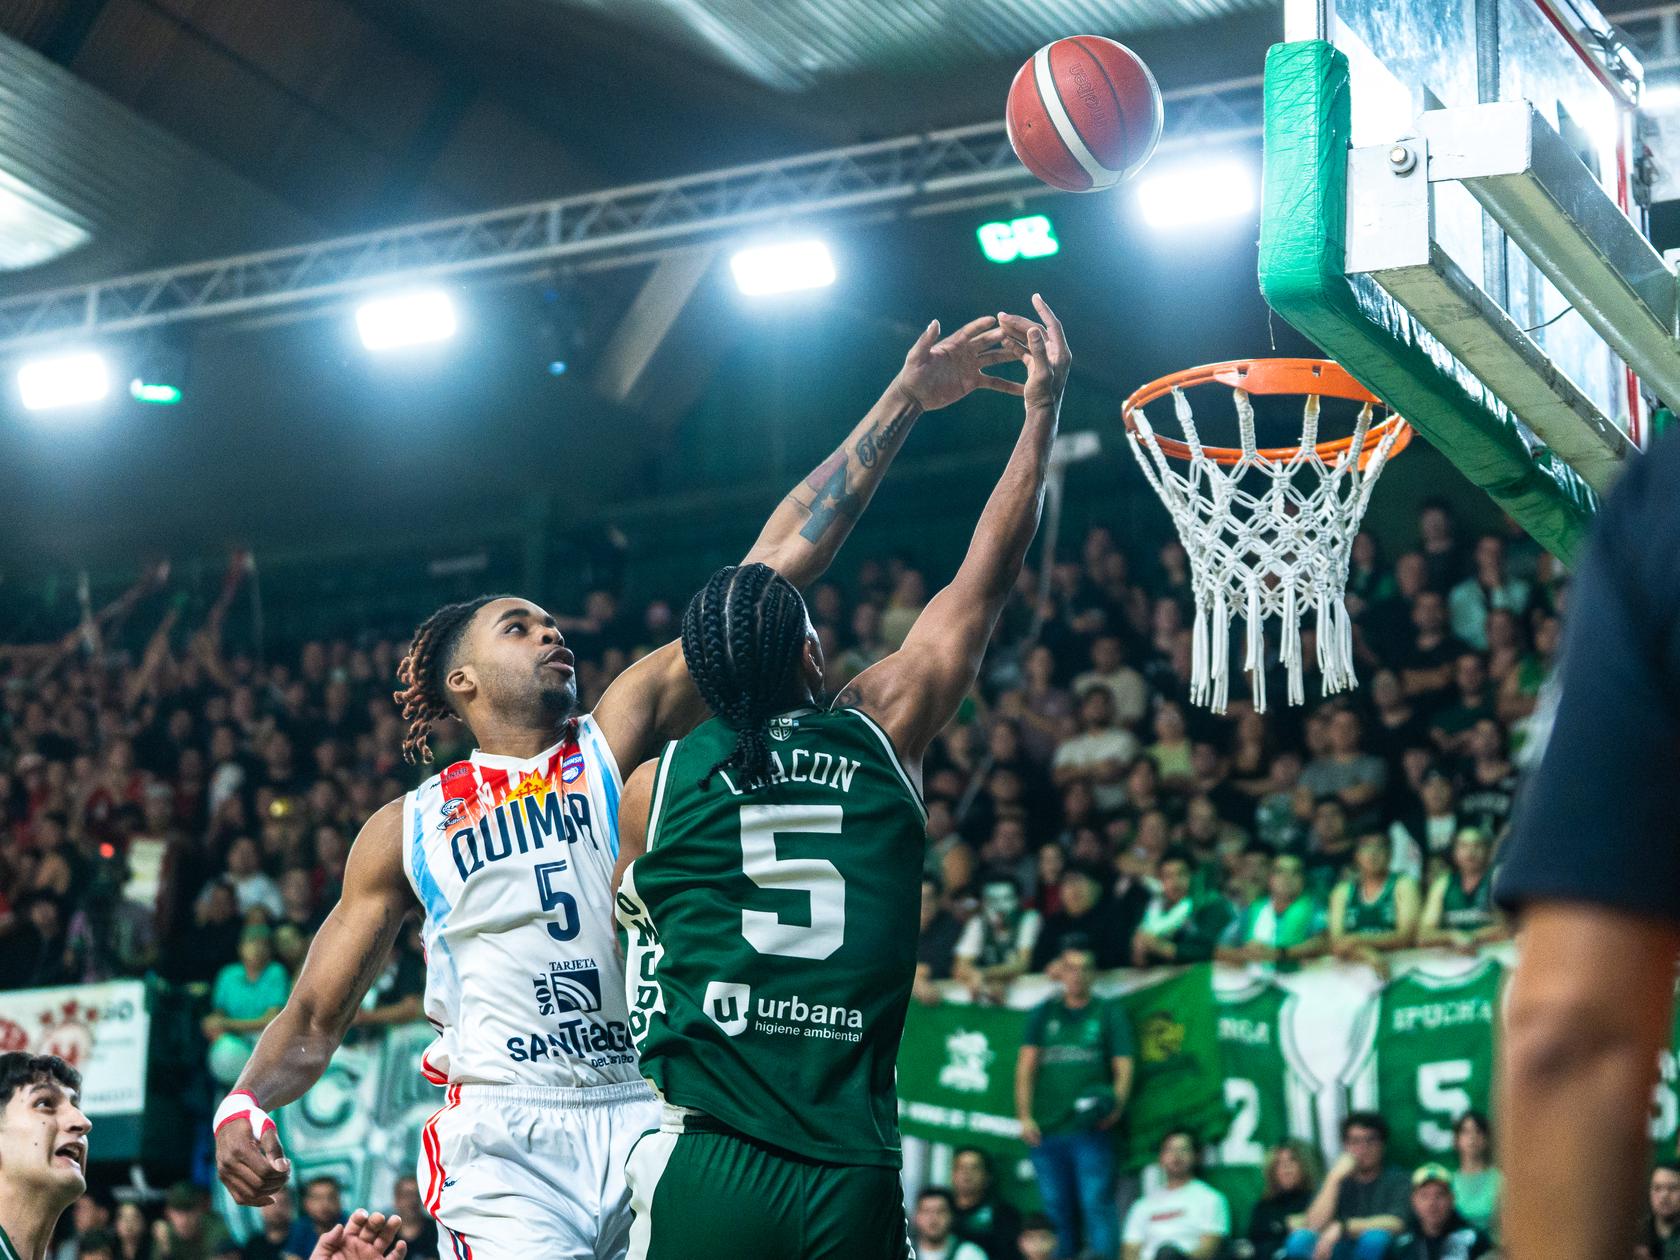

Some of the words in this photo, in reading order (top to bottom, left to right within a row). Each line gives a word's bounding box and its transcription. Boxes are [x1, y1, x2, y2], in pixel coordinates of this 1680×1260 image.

[718, 748, 861, 796] CACON
[534, 859, 581, 942] 5
[740, 804, 846, 961] 5
[548, 957, 597, 972] TARJETA
[532, 972, 556, 1017] SOL
[757, 995, 863, 1029] urbana
[755, 1020, 801, 1036] higiene
[803, 1027, 863, 1043] ambiental
